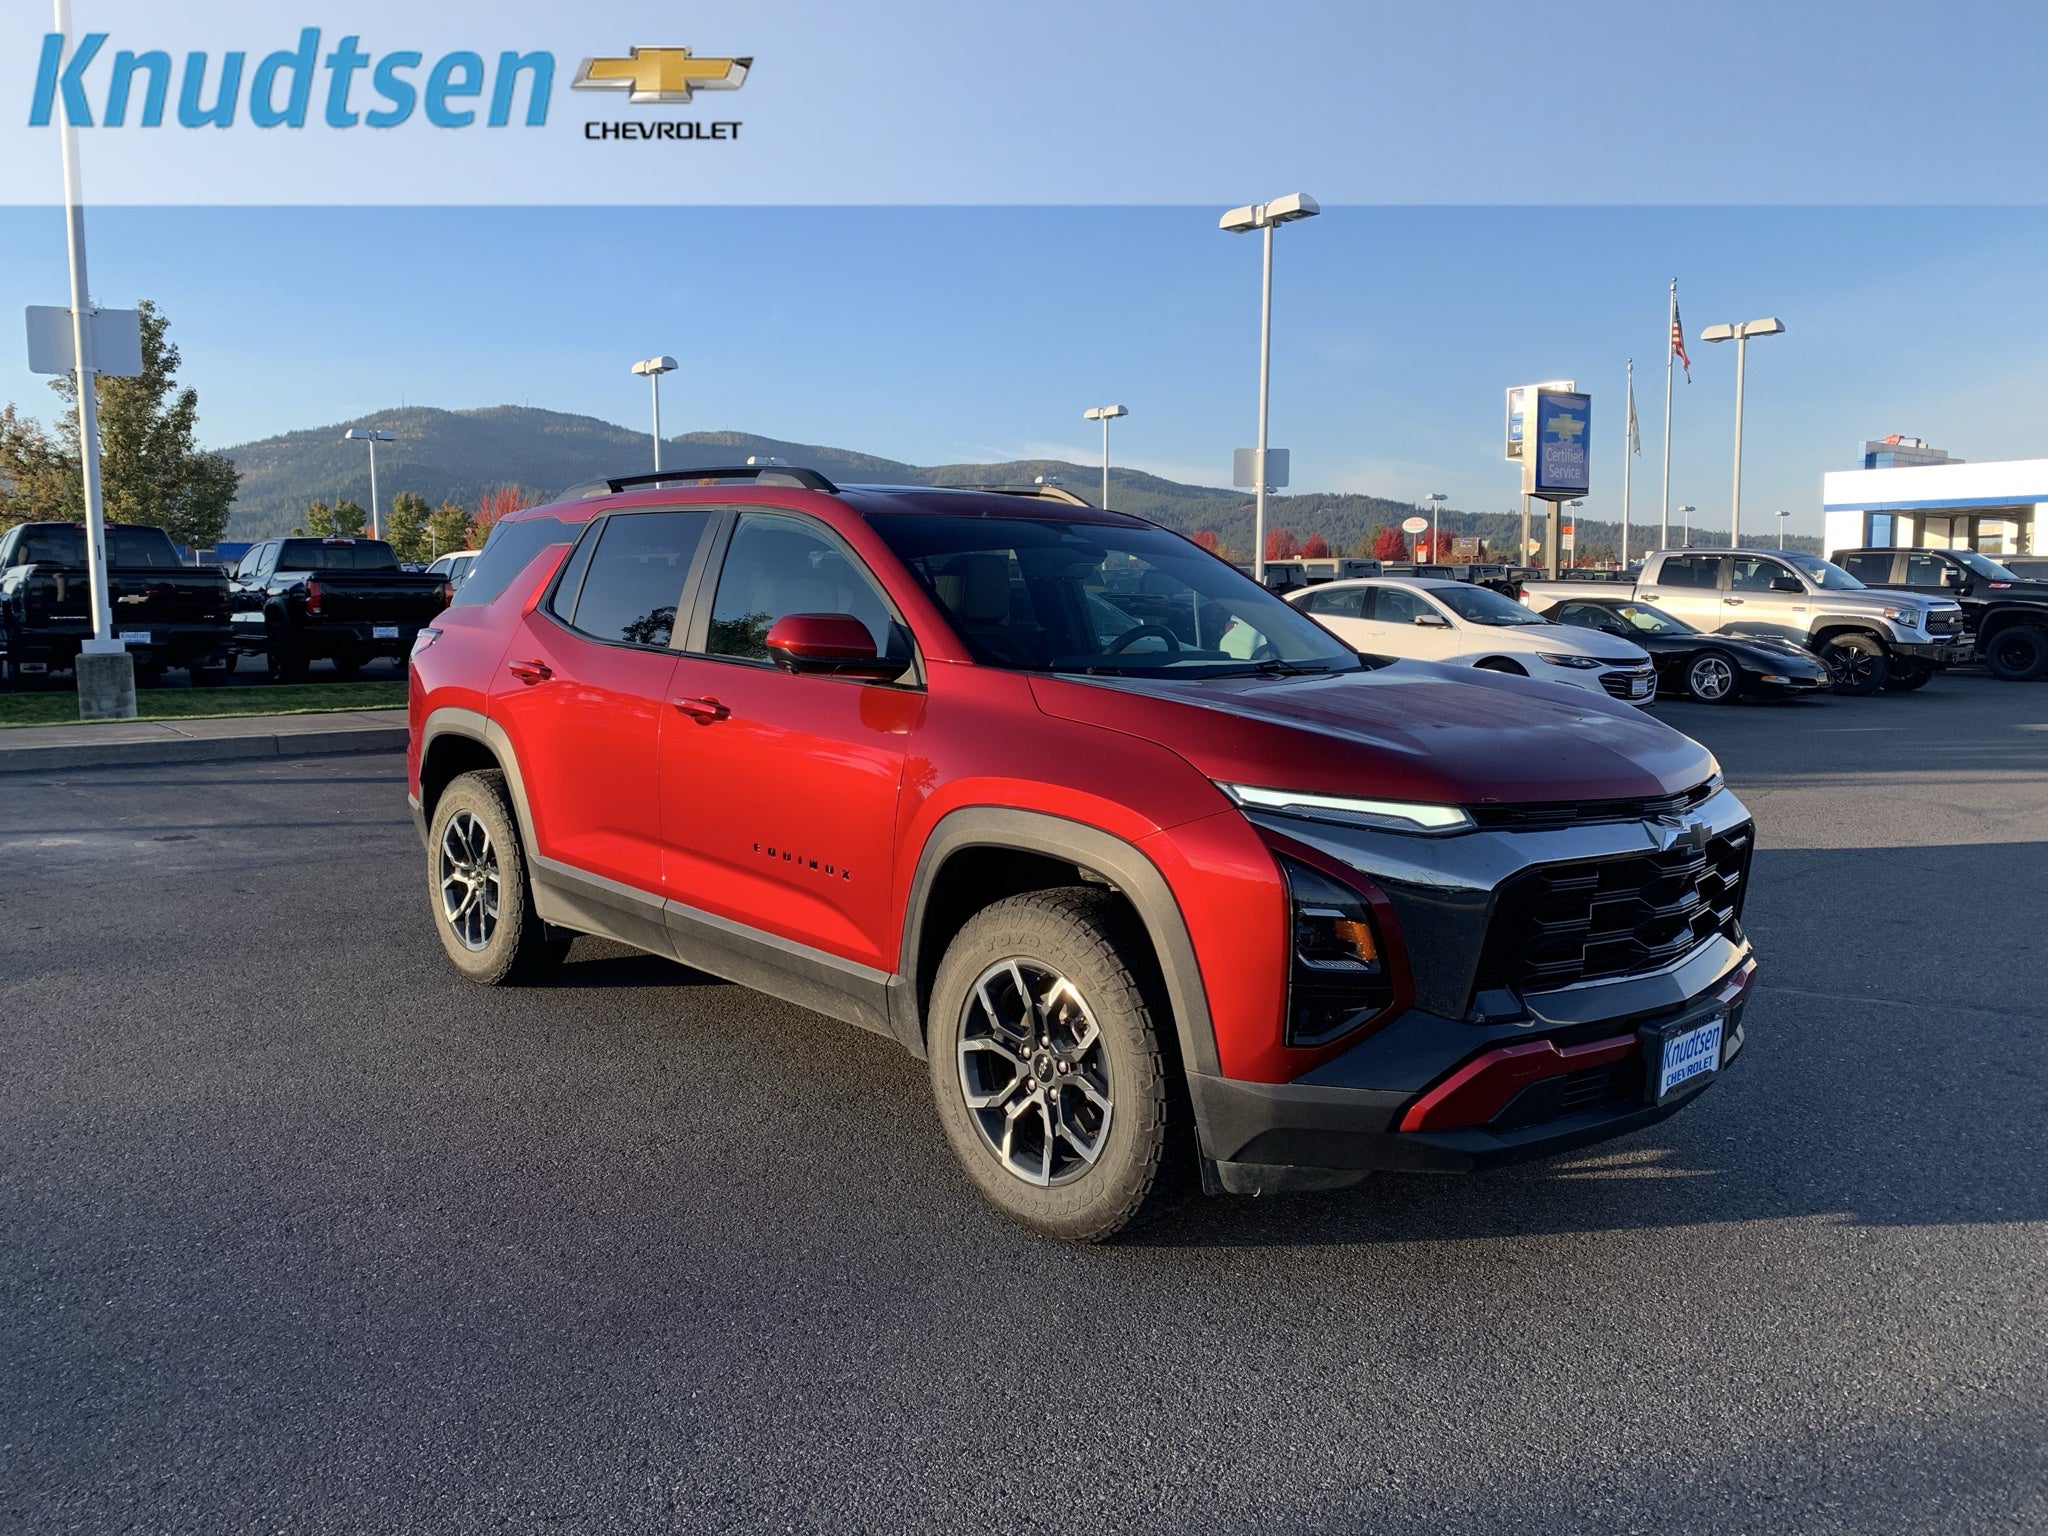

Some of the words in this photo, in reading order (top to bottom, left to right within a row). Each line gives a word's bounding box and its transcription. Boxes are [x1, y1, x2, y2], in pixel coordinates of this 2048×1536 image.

[1546, 446, 1584, 464] Certified
[1548, 464, 1581, 479] Service
[753, 842, 851, 881] EQUINOX
[1662, 1026, 1720, 1071] Knudtsen
[1666, 1055, 1713, 1087] CHEVROLET
